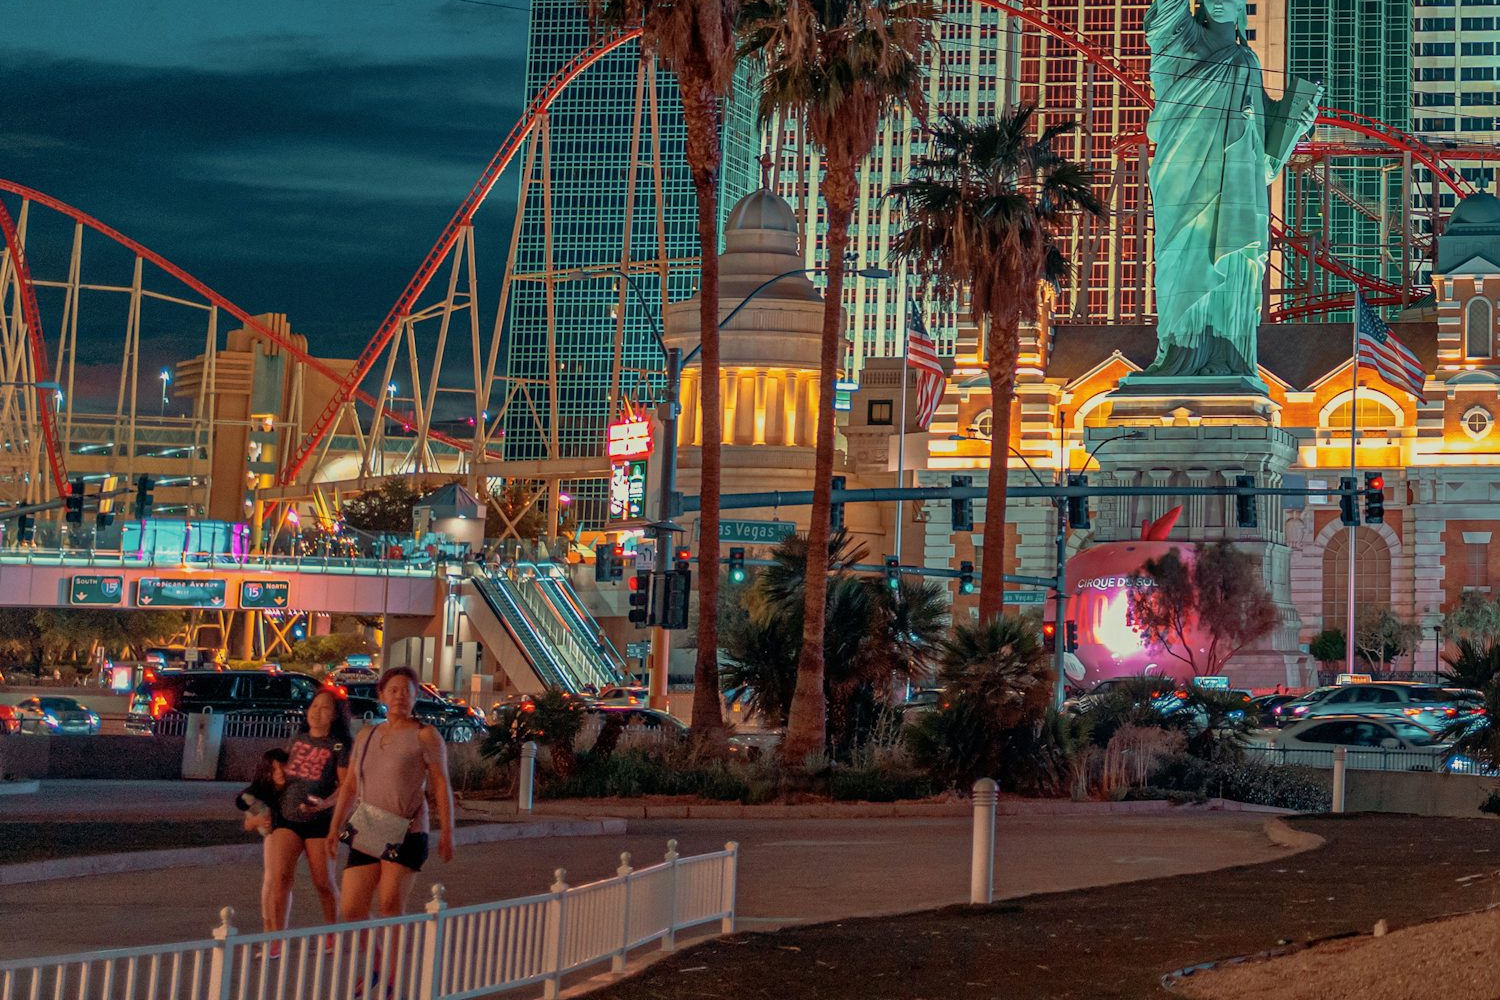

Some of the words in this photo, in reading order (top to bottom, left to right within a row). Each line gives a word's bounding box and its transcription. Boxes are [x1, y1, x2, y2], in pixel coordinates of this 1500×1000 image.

[718, 524, 731, 536] as
[736, 523, 774, 540] Vegas
[148, 580, 186, 588] Tropicana
[1077, 577, 1115, 590] CIRQUE
[1136, 577, 1159, 588] SOL
[105, 584, 117, 593] 15
[248, 589, 259, 597] 15
